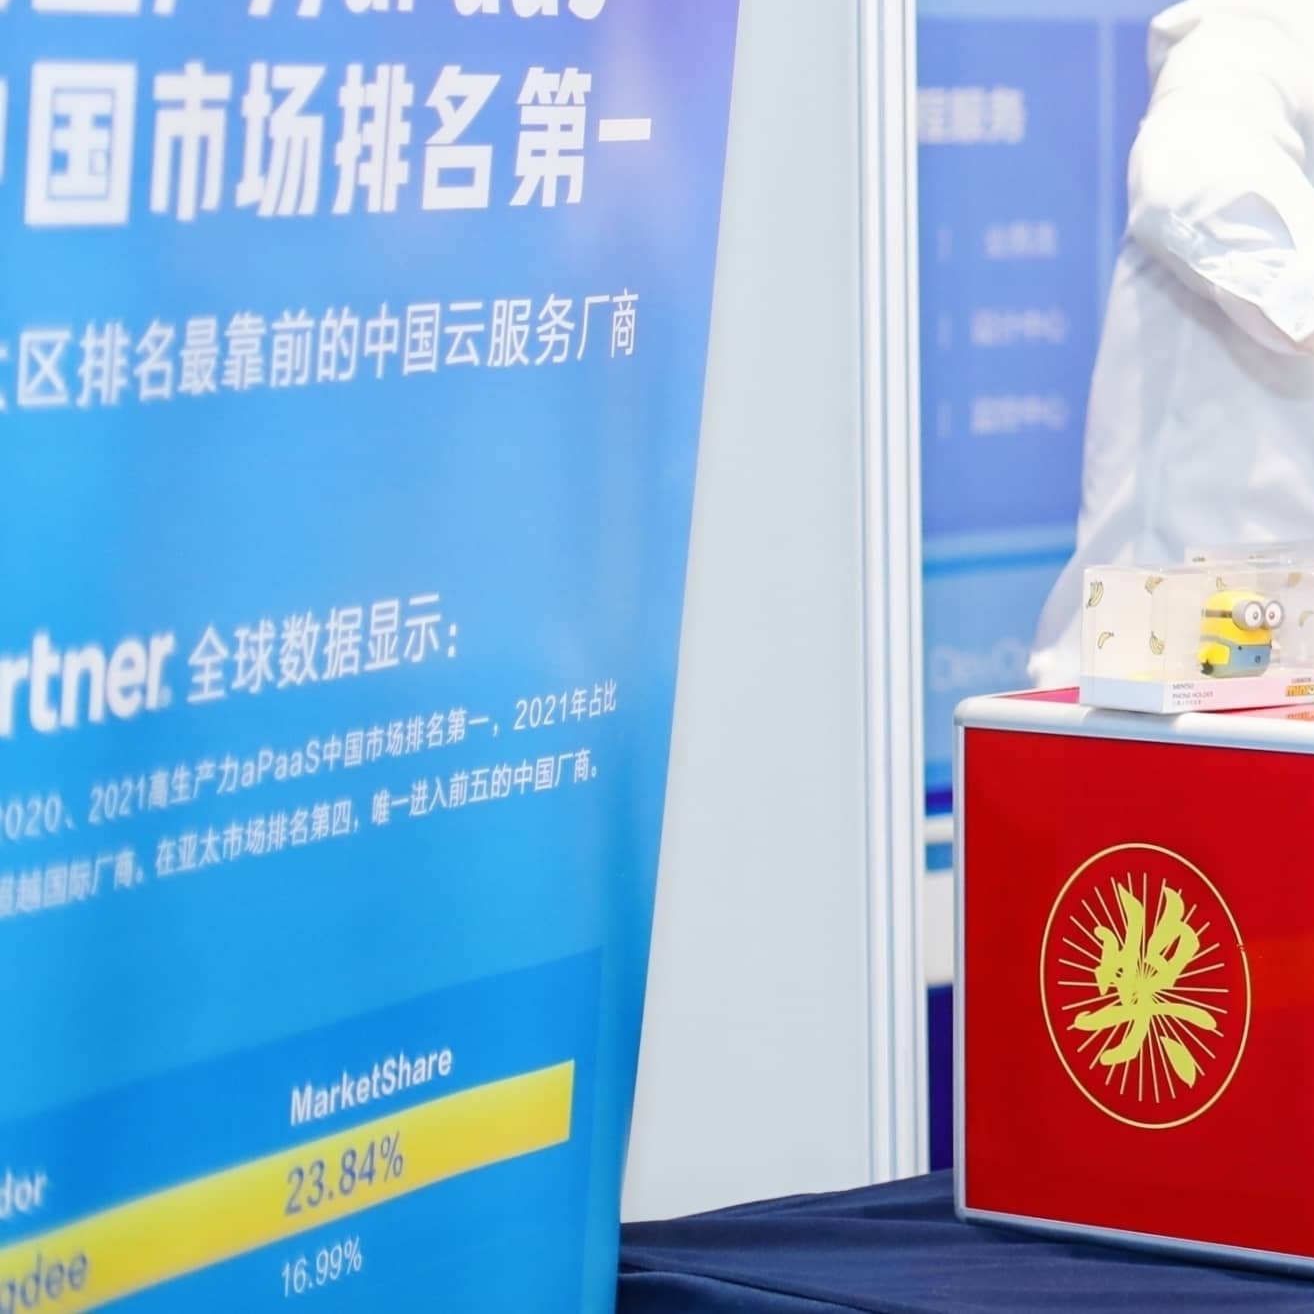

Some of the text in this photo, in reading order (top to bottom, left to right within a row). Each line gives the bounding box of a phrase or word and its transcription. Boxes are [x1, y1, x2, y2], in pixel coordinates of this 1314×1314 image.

[0, 60, 653, 229] 国市场排名第一
[0, 287, 640, 413] 区排名最靠前的中国云服务厂商
[289, 1047, 454, 1127] MarketShare
[283, 1129, 405, 1219] 23.84%
[280, 1235, 363, 1299] 16.99%
